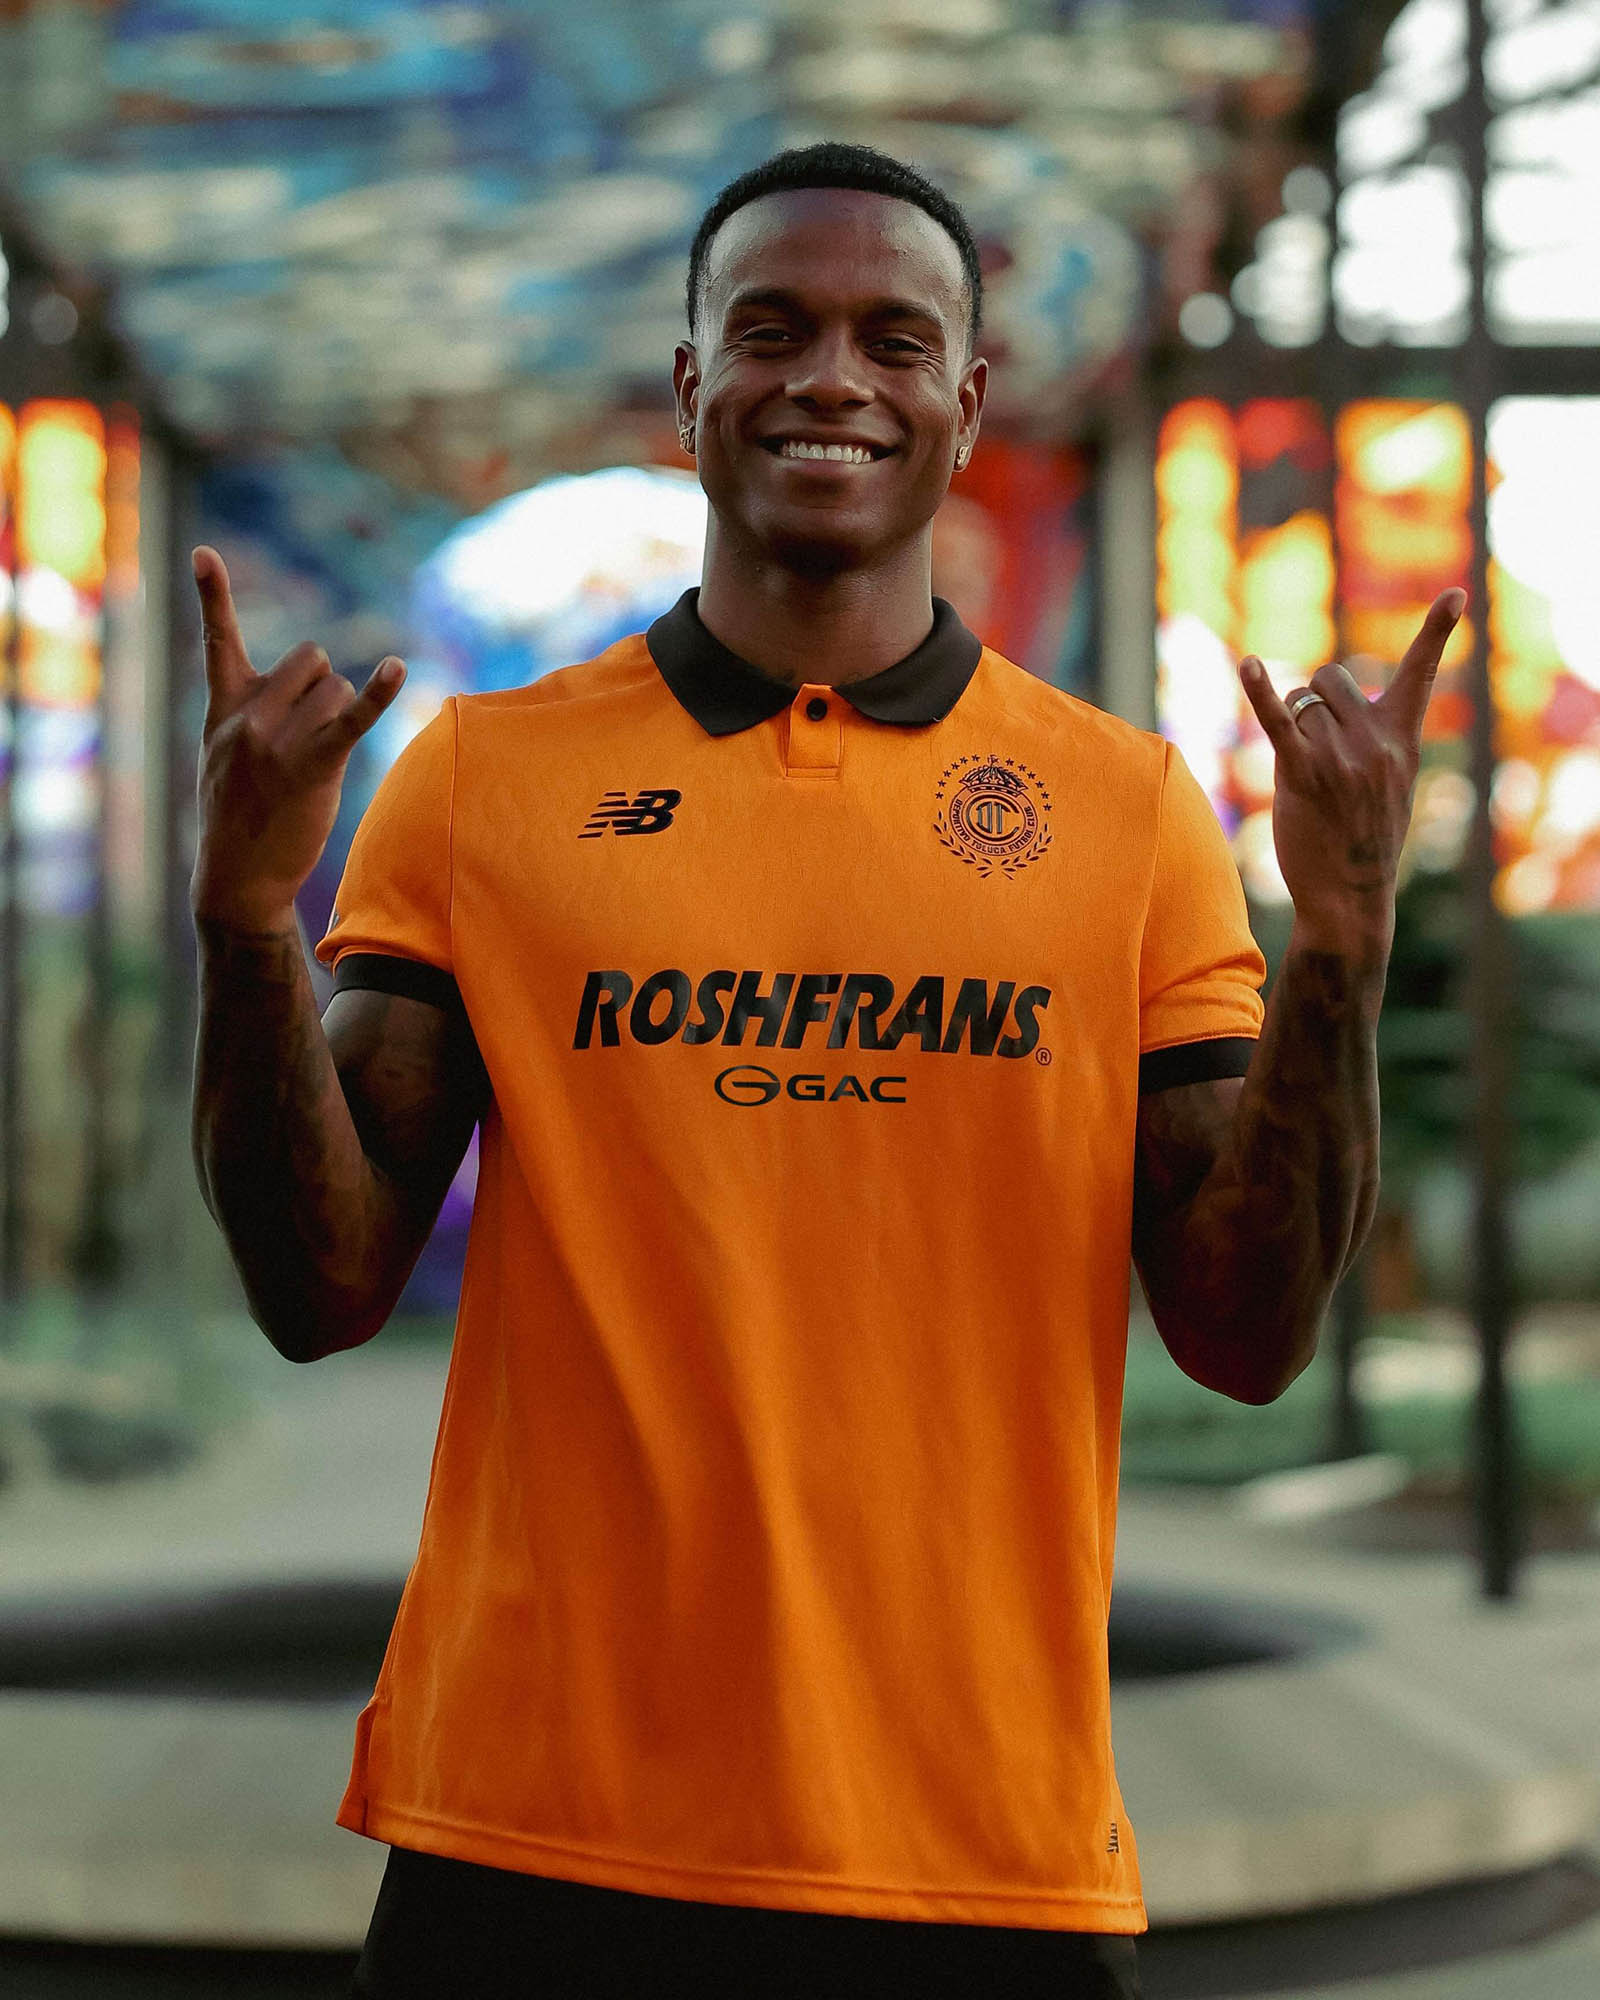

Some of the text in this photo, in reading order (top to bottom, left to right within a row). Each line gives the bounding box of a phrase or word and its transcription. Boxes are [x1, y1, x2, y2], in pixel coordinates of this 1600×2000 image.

[971, 840, 1007, 854] TOLUCA
[573, 969, 1052, 1059] ROSHFRANS
[786, 1074, 907, 1103] GAC
